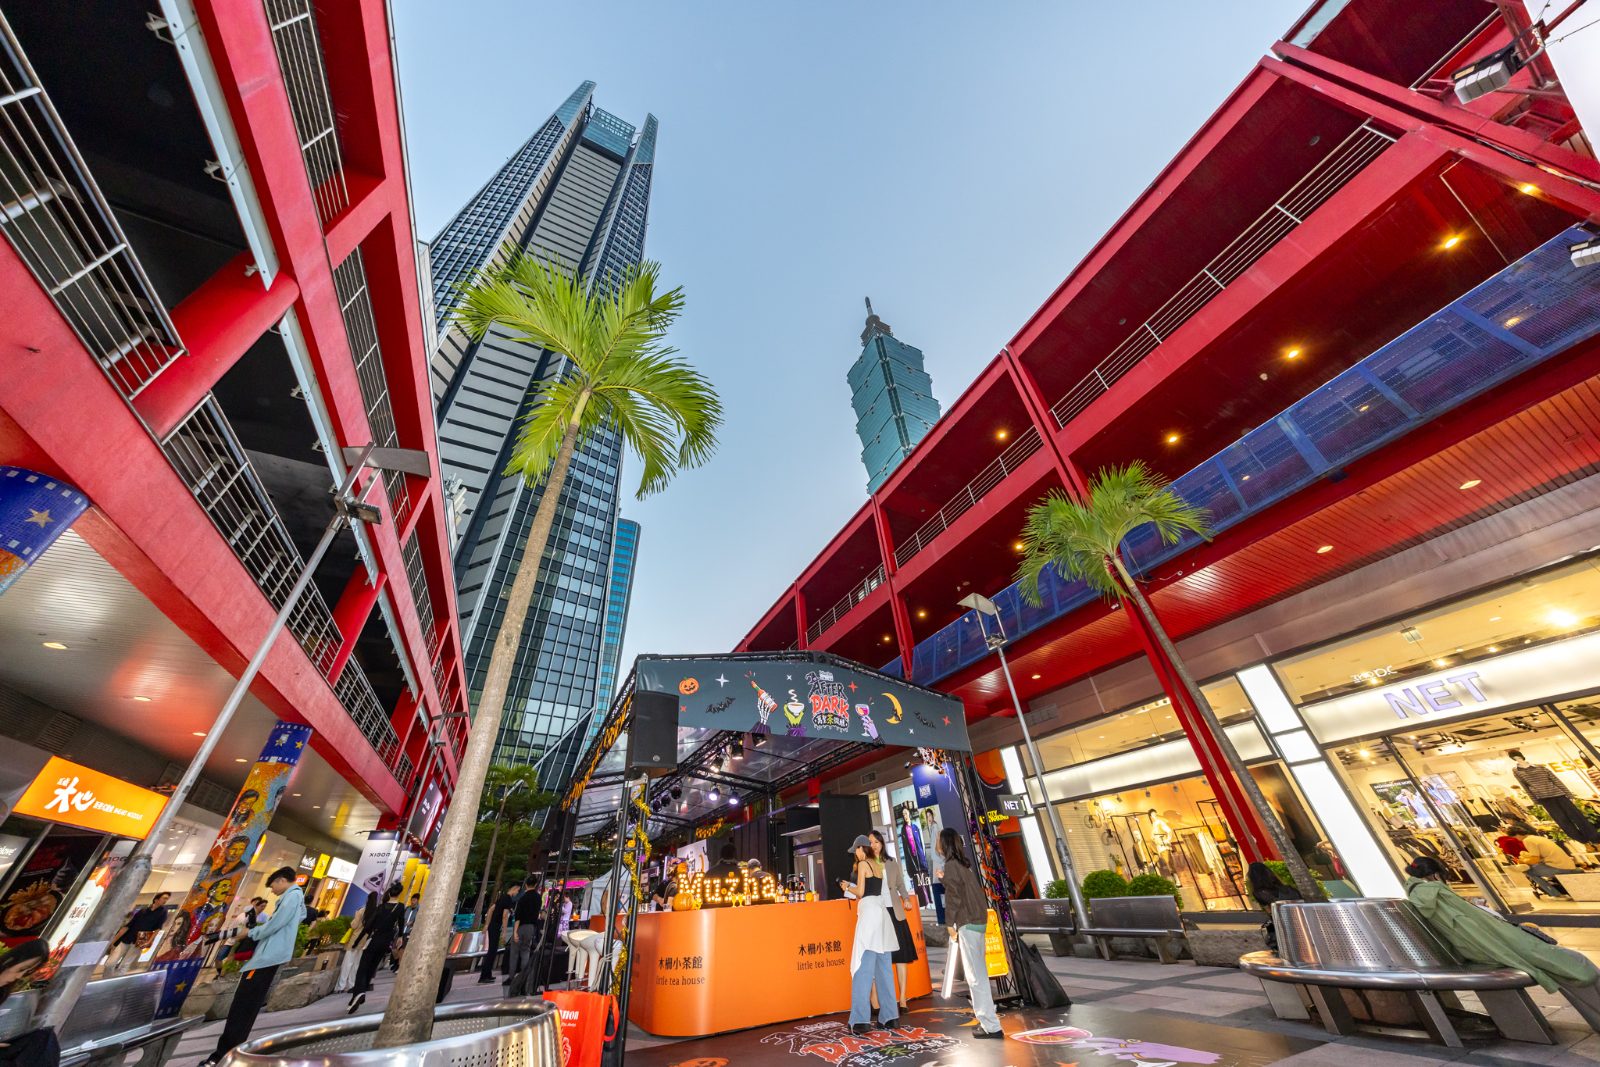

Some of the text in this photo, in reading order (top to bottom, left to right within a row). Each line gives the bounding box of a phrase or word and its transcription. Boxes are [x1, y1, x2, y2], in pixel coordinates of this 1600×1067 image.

[805, 671, 848, 701] AFTER
[1383, 671, 1488, 720] NET
[810, 694, 849, 719] DARK
[1003, 800, 1020, 811] NET
[677, 868, 776, 903] Muzha
[798, 940, 842, 956] 木柵小茶館
[658, 956, 703, 970] 木柵小茶館
[797, 957, 846, 971] little tea house
[669, 977, 680, 986] tea
[681, 976, 705, 986] house
[800, 1025, 946, 1065] DARK
